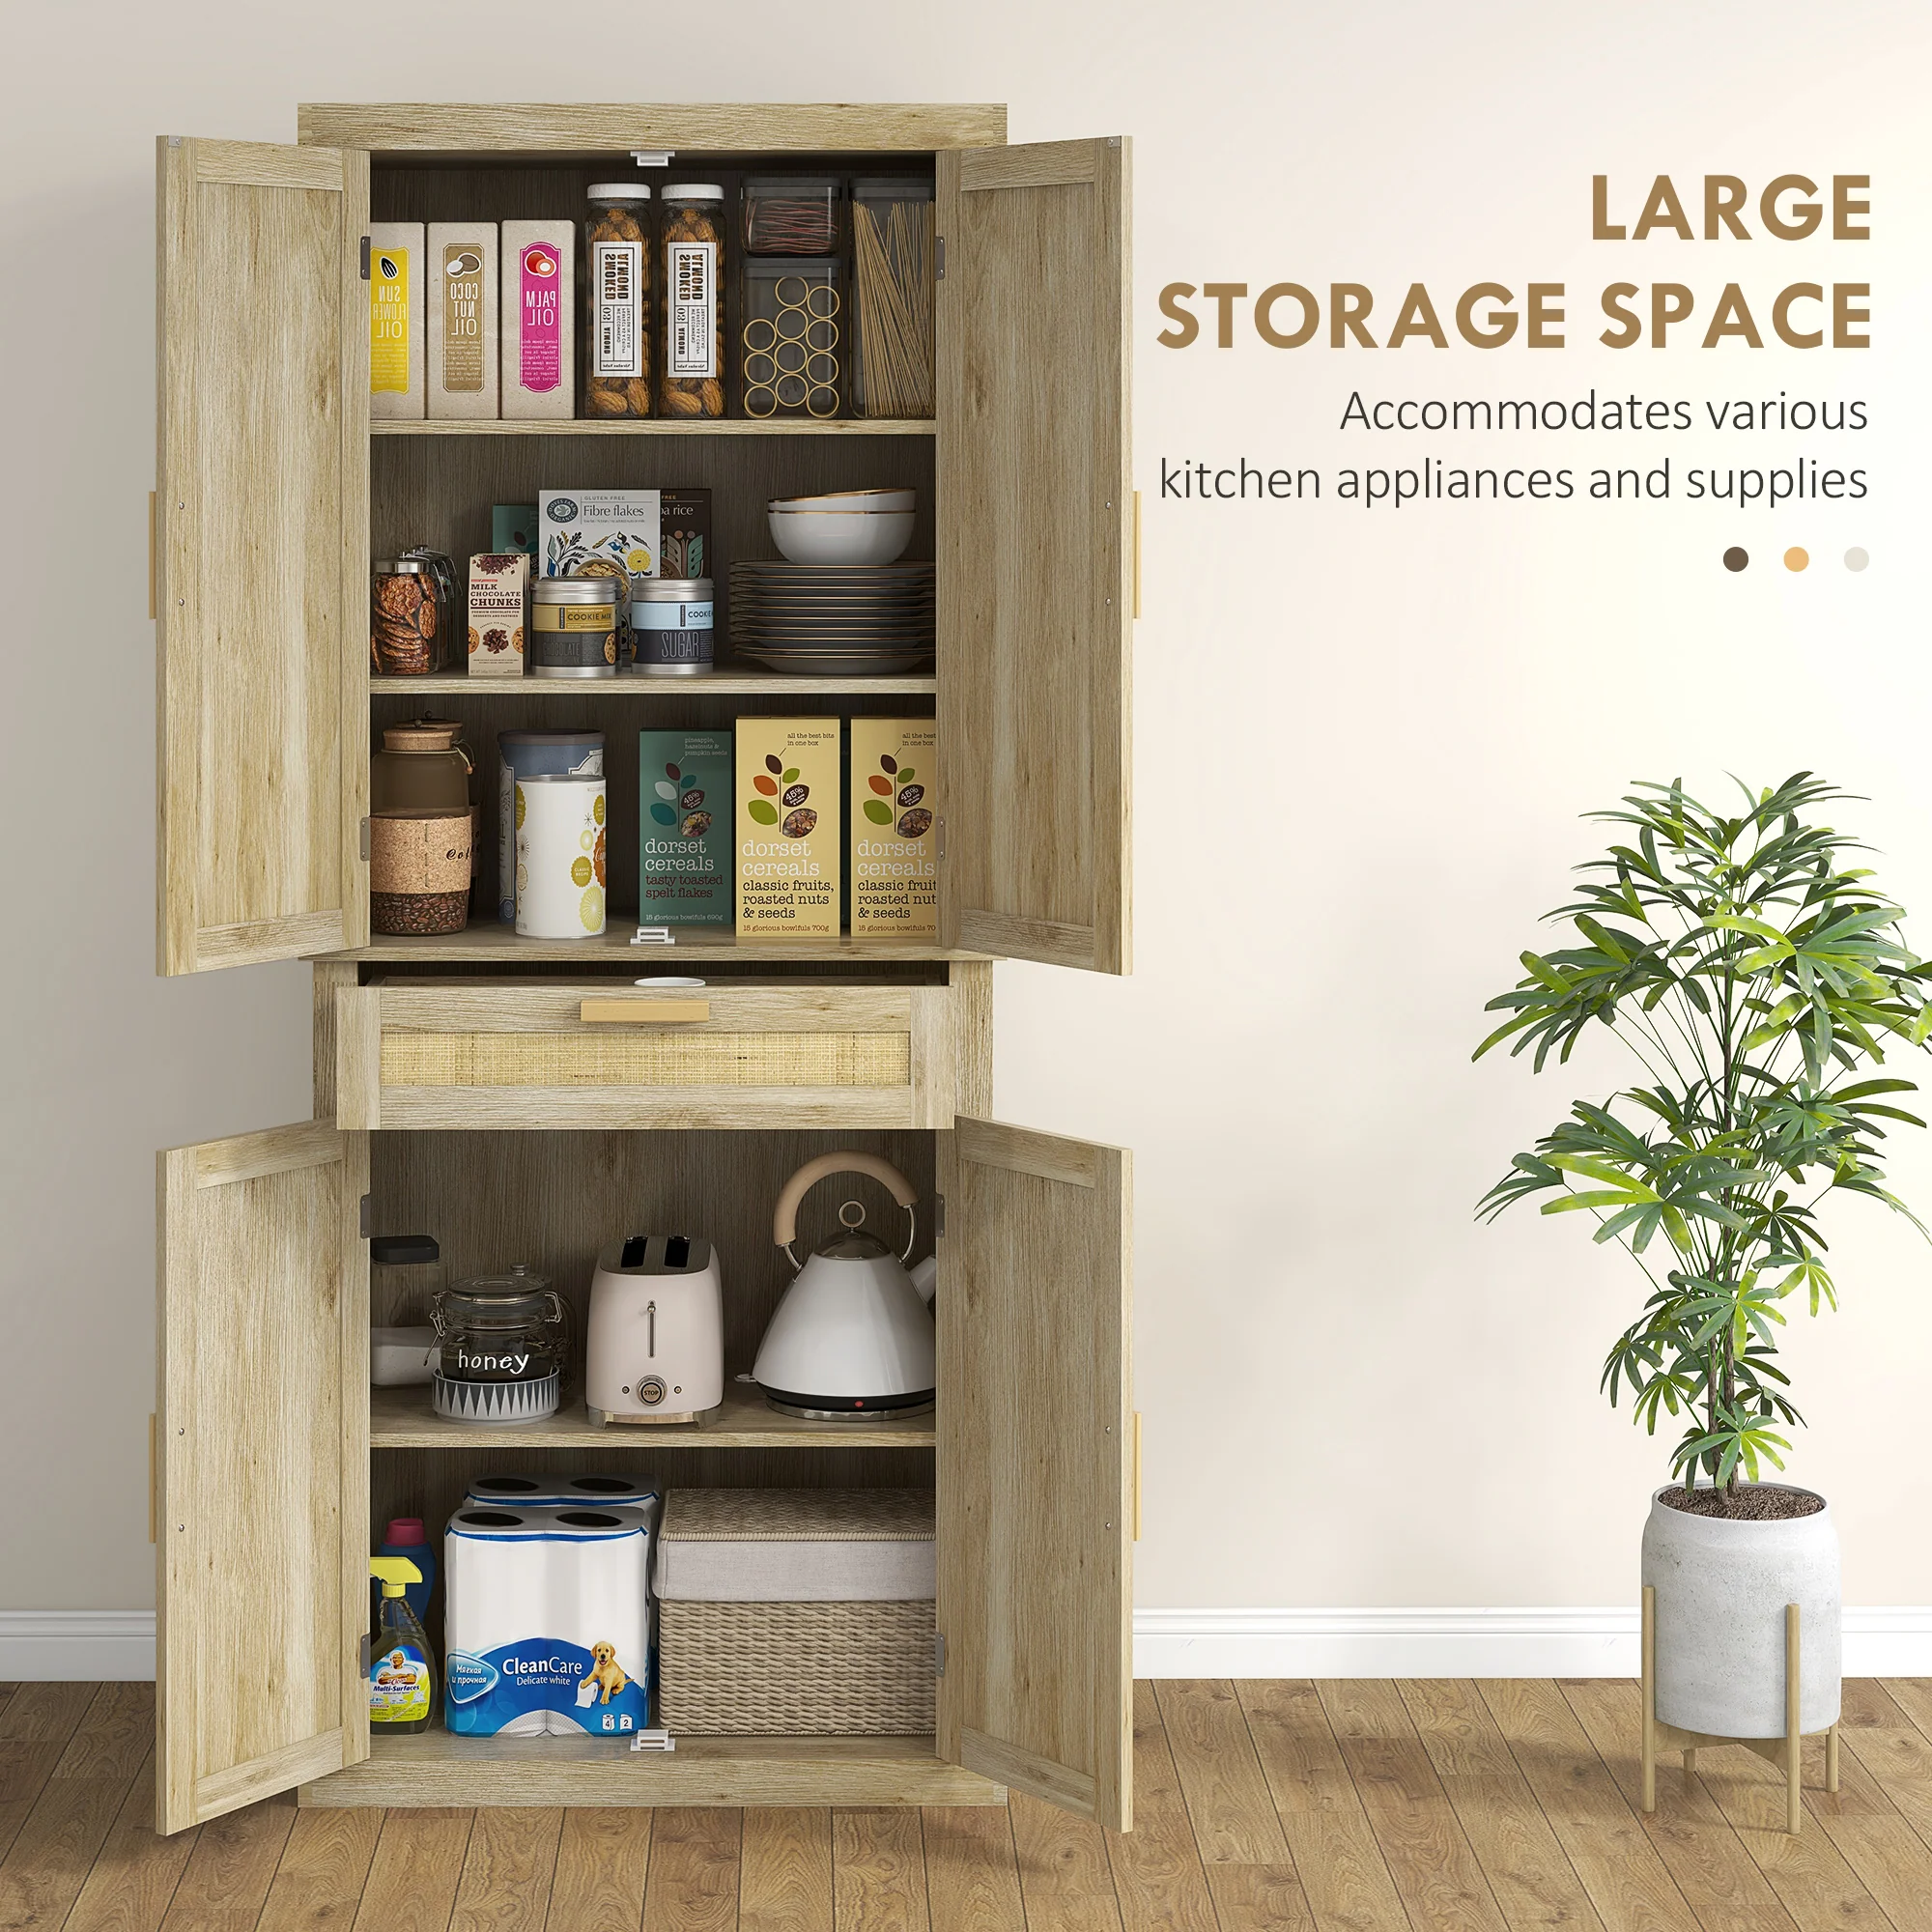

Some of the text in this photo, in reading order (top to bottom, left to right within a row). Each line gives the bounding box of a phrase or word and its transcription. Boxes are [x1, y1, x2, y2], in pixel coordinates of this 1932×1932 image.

[583, 504, 644, 516] Fibre flakes
[673, 504, 694, 515] rice
[662, 632, 698, 657] SUGAR
[644, 838, 707, 853] dorset
[742, 839, 811, 857] dorset
[857, 839, 926, 857] dorset
[644, 856, 714, 871] cereals
[742, 859, 820, 876] cereals
[857, 859, 935, 876] cereals
[645, 875, 723, 887] tasty toasted
[743, 880, 834, 893] classic fruits,
[858, 880, 936, 891] classic fruit
[645, 888, 713, 899] spelt flakes
[743, 894, 829, 904] roasted nuts
[858, 894, 936, 904] roasted nut
[743, 907, 795, 918] & seeds
[858, 907, 911, 918] & seeds
[458, 1349, 529, 1375] honey
[456, 1664, 482, 1674] Мягкая
[502, 1657, 582, 1675] CleanCare
[458, 1676, 487, 1687] прочная
[516, 1676, 571, 1686] Delicate white
